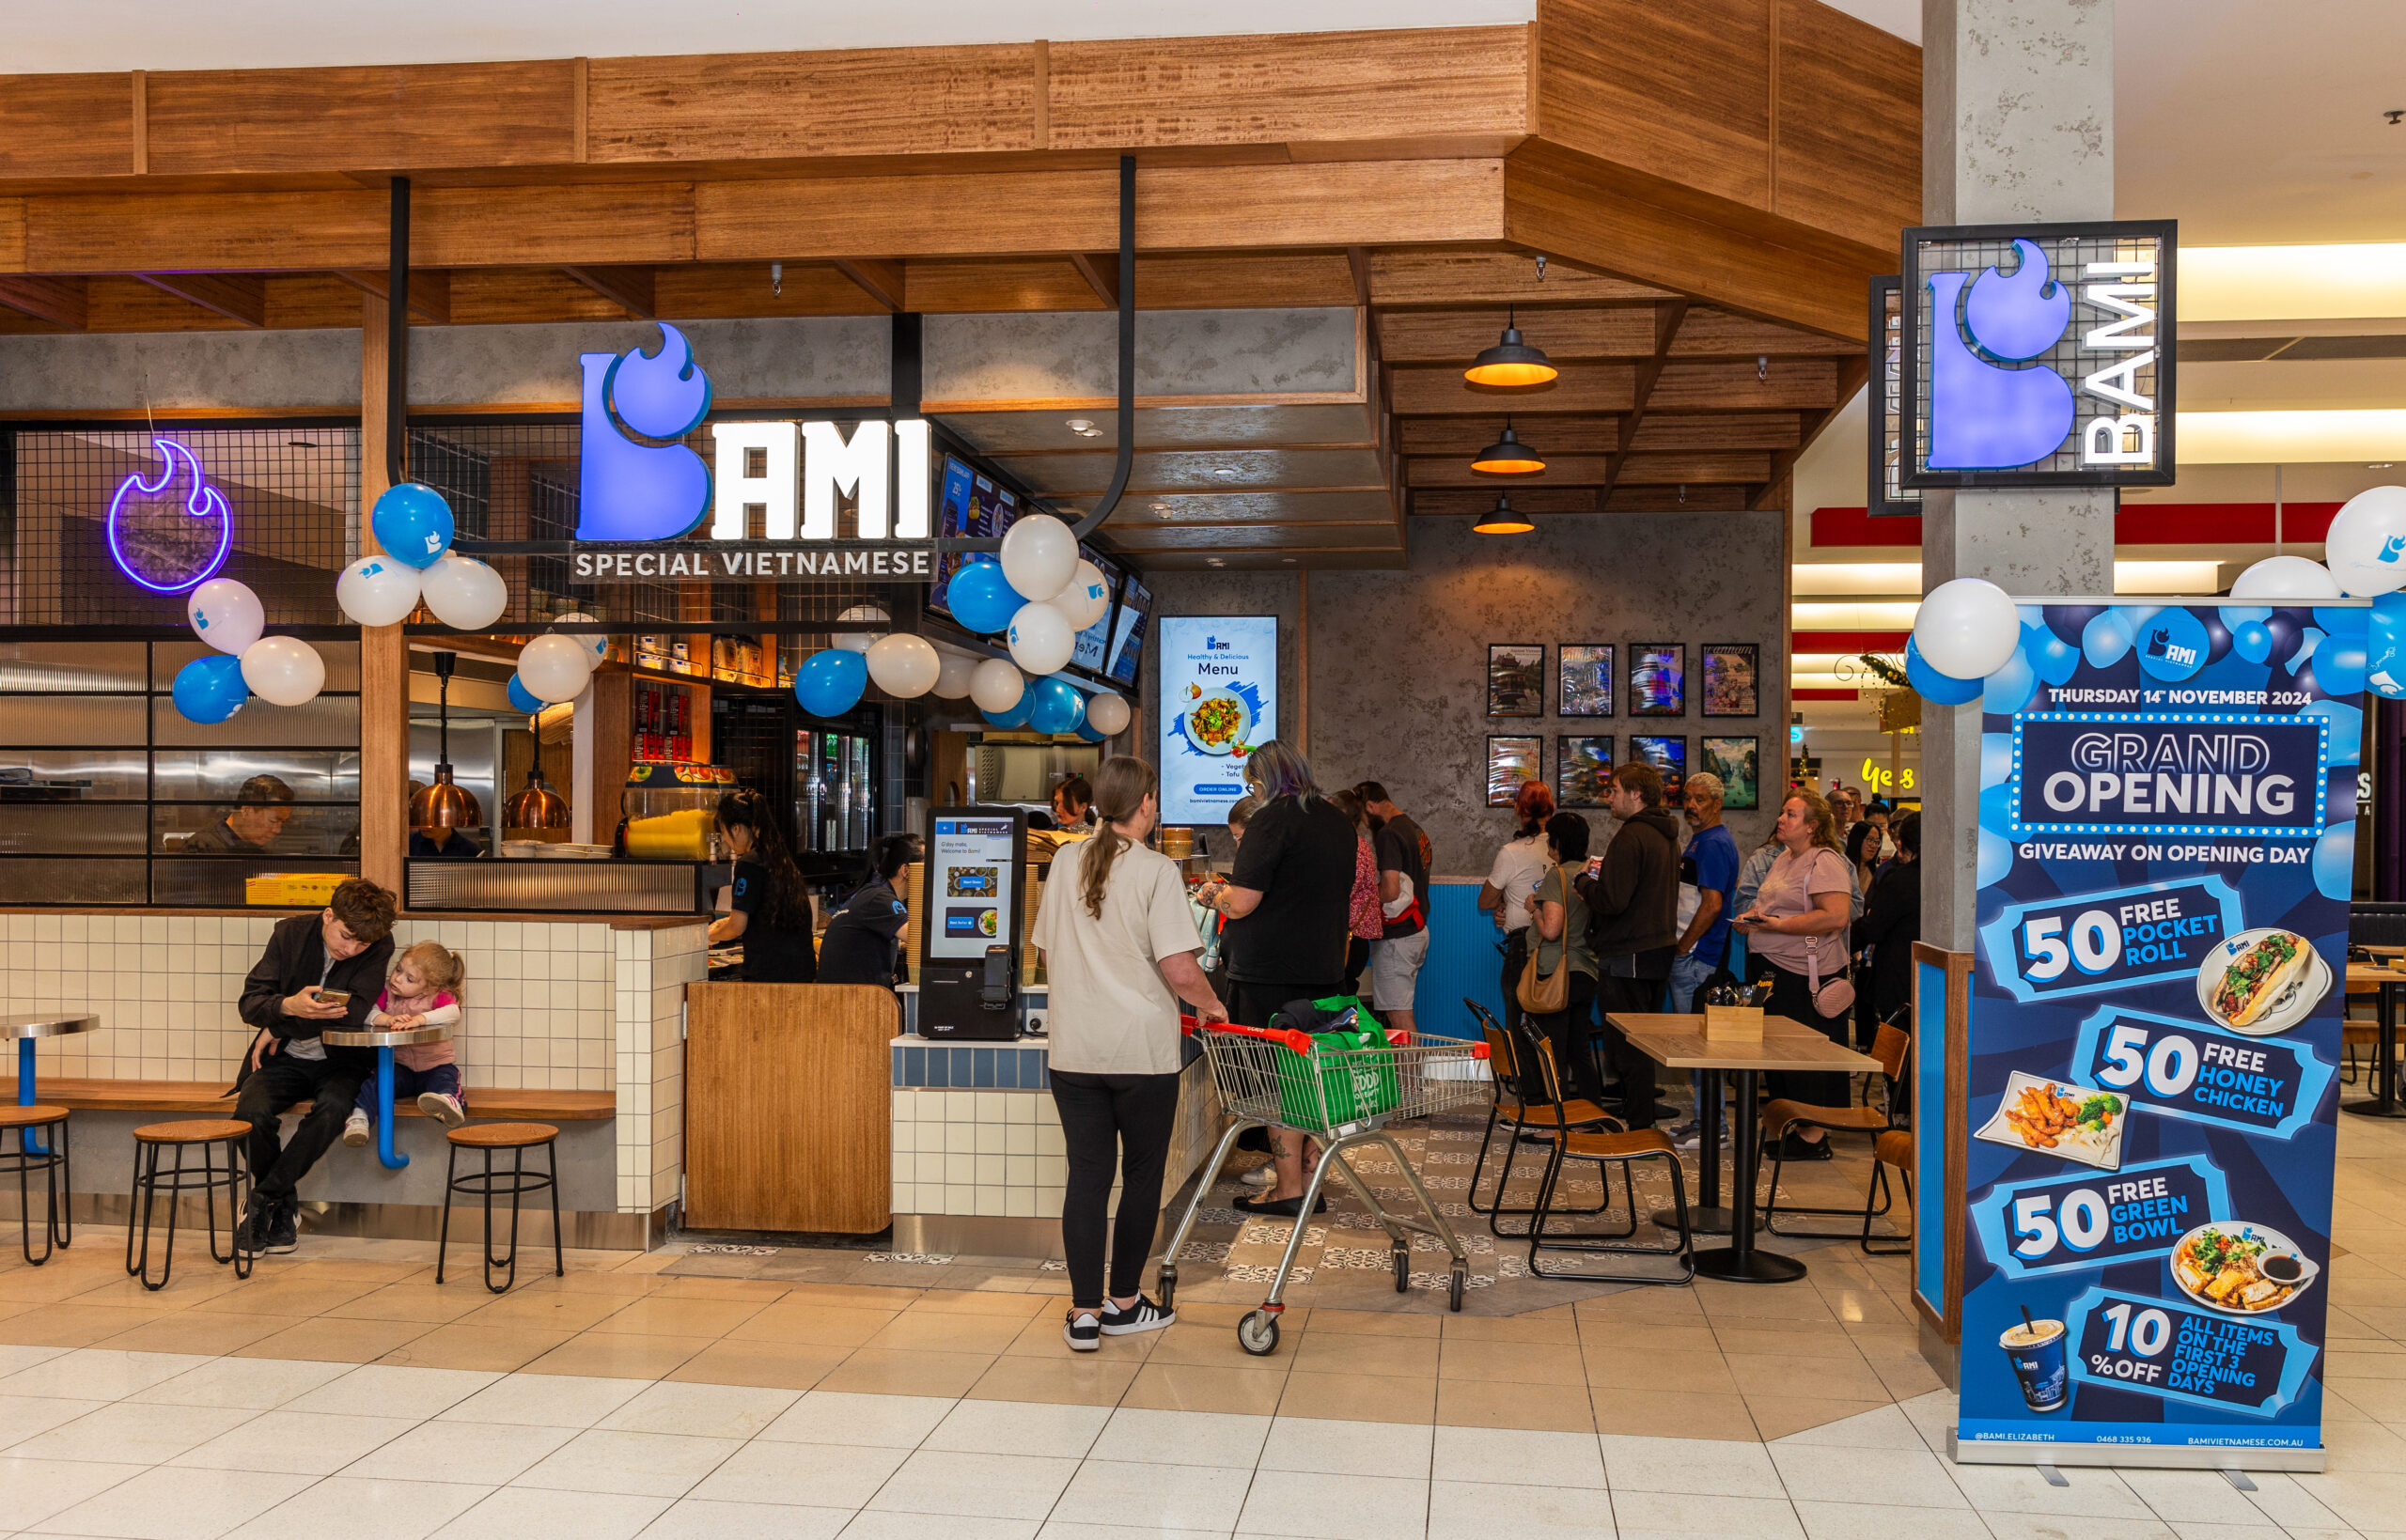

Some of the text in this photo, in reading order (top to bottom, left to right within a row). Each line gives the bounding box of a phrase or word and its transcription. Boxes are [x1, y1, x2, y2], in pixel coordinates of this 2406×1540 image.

[2081, 262, 2156, 466] BAMI
[574, 321, 932, 541] BAMI
[575, 551, 930, 578] SPECIAL VIETNAMESE
[1207, 634, 1230, 650] BAMI
[2147, 627, 2197, 665] BAMI
[1198, 662, 1239, 675] Menu
[2048, 689, 2141, 703] THURSDAY
[2168, 690, 2268, 705] NOVEMBER
[2272, 692, 2312, 705] 2024
[2070, 733, 2271, 774] GRAND
[2043, 771, 2295, 815] OPENING
[2019, 844, 2311, 864] GIVEAWAY ON OPENING DAY
[2119, 898, 2181, 926] FREE
[2122, 914, 2218, 946] POCKET
[2021, 910, 2122, 984] 50
[2125, 941, 2187, 967] ROLL
[2226, 941, 2250, 956] BAMI
[2093, 1024, 2199, 1098] 50
[2203, 1042, 2267, 1073] FREE
[2197, 1064, 2285, 1097] HONEY
[2194, 1087, 2284, 1118] CHICKEN
[2107, 1176, 2167, 1205] FREE
[2110, 1195, 2188, 1223] GREEN
[2012, 1189, 2111, 1260] 50
[2113, 1219, 2184, 1244] BOWL
[2101, 1303, 2171, 1358] 10
[2178, 1330, 2247, 1358] ON THE
[2179, 1315, 2274, 1346] ALL ITEMS
[2174, 1345, 2240, 1370] FIRST 3
[2167, 1372, 2216, 1395] DAYS
[2171, 1359, 2256, 1388] OPENING
[1975, 1432, 2304, 1448] @BAMI.ELIZABETH 0468 335 936 BAMIVIETNAMESE.COM.AU
